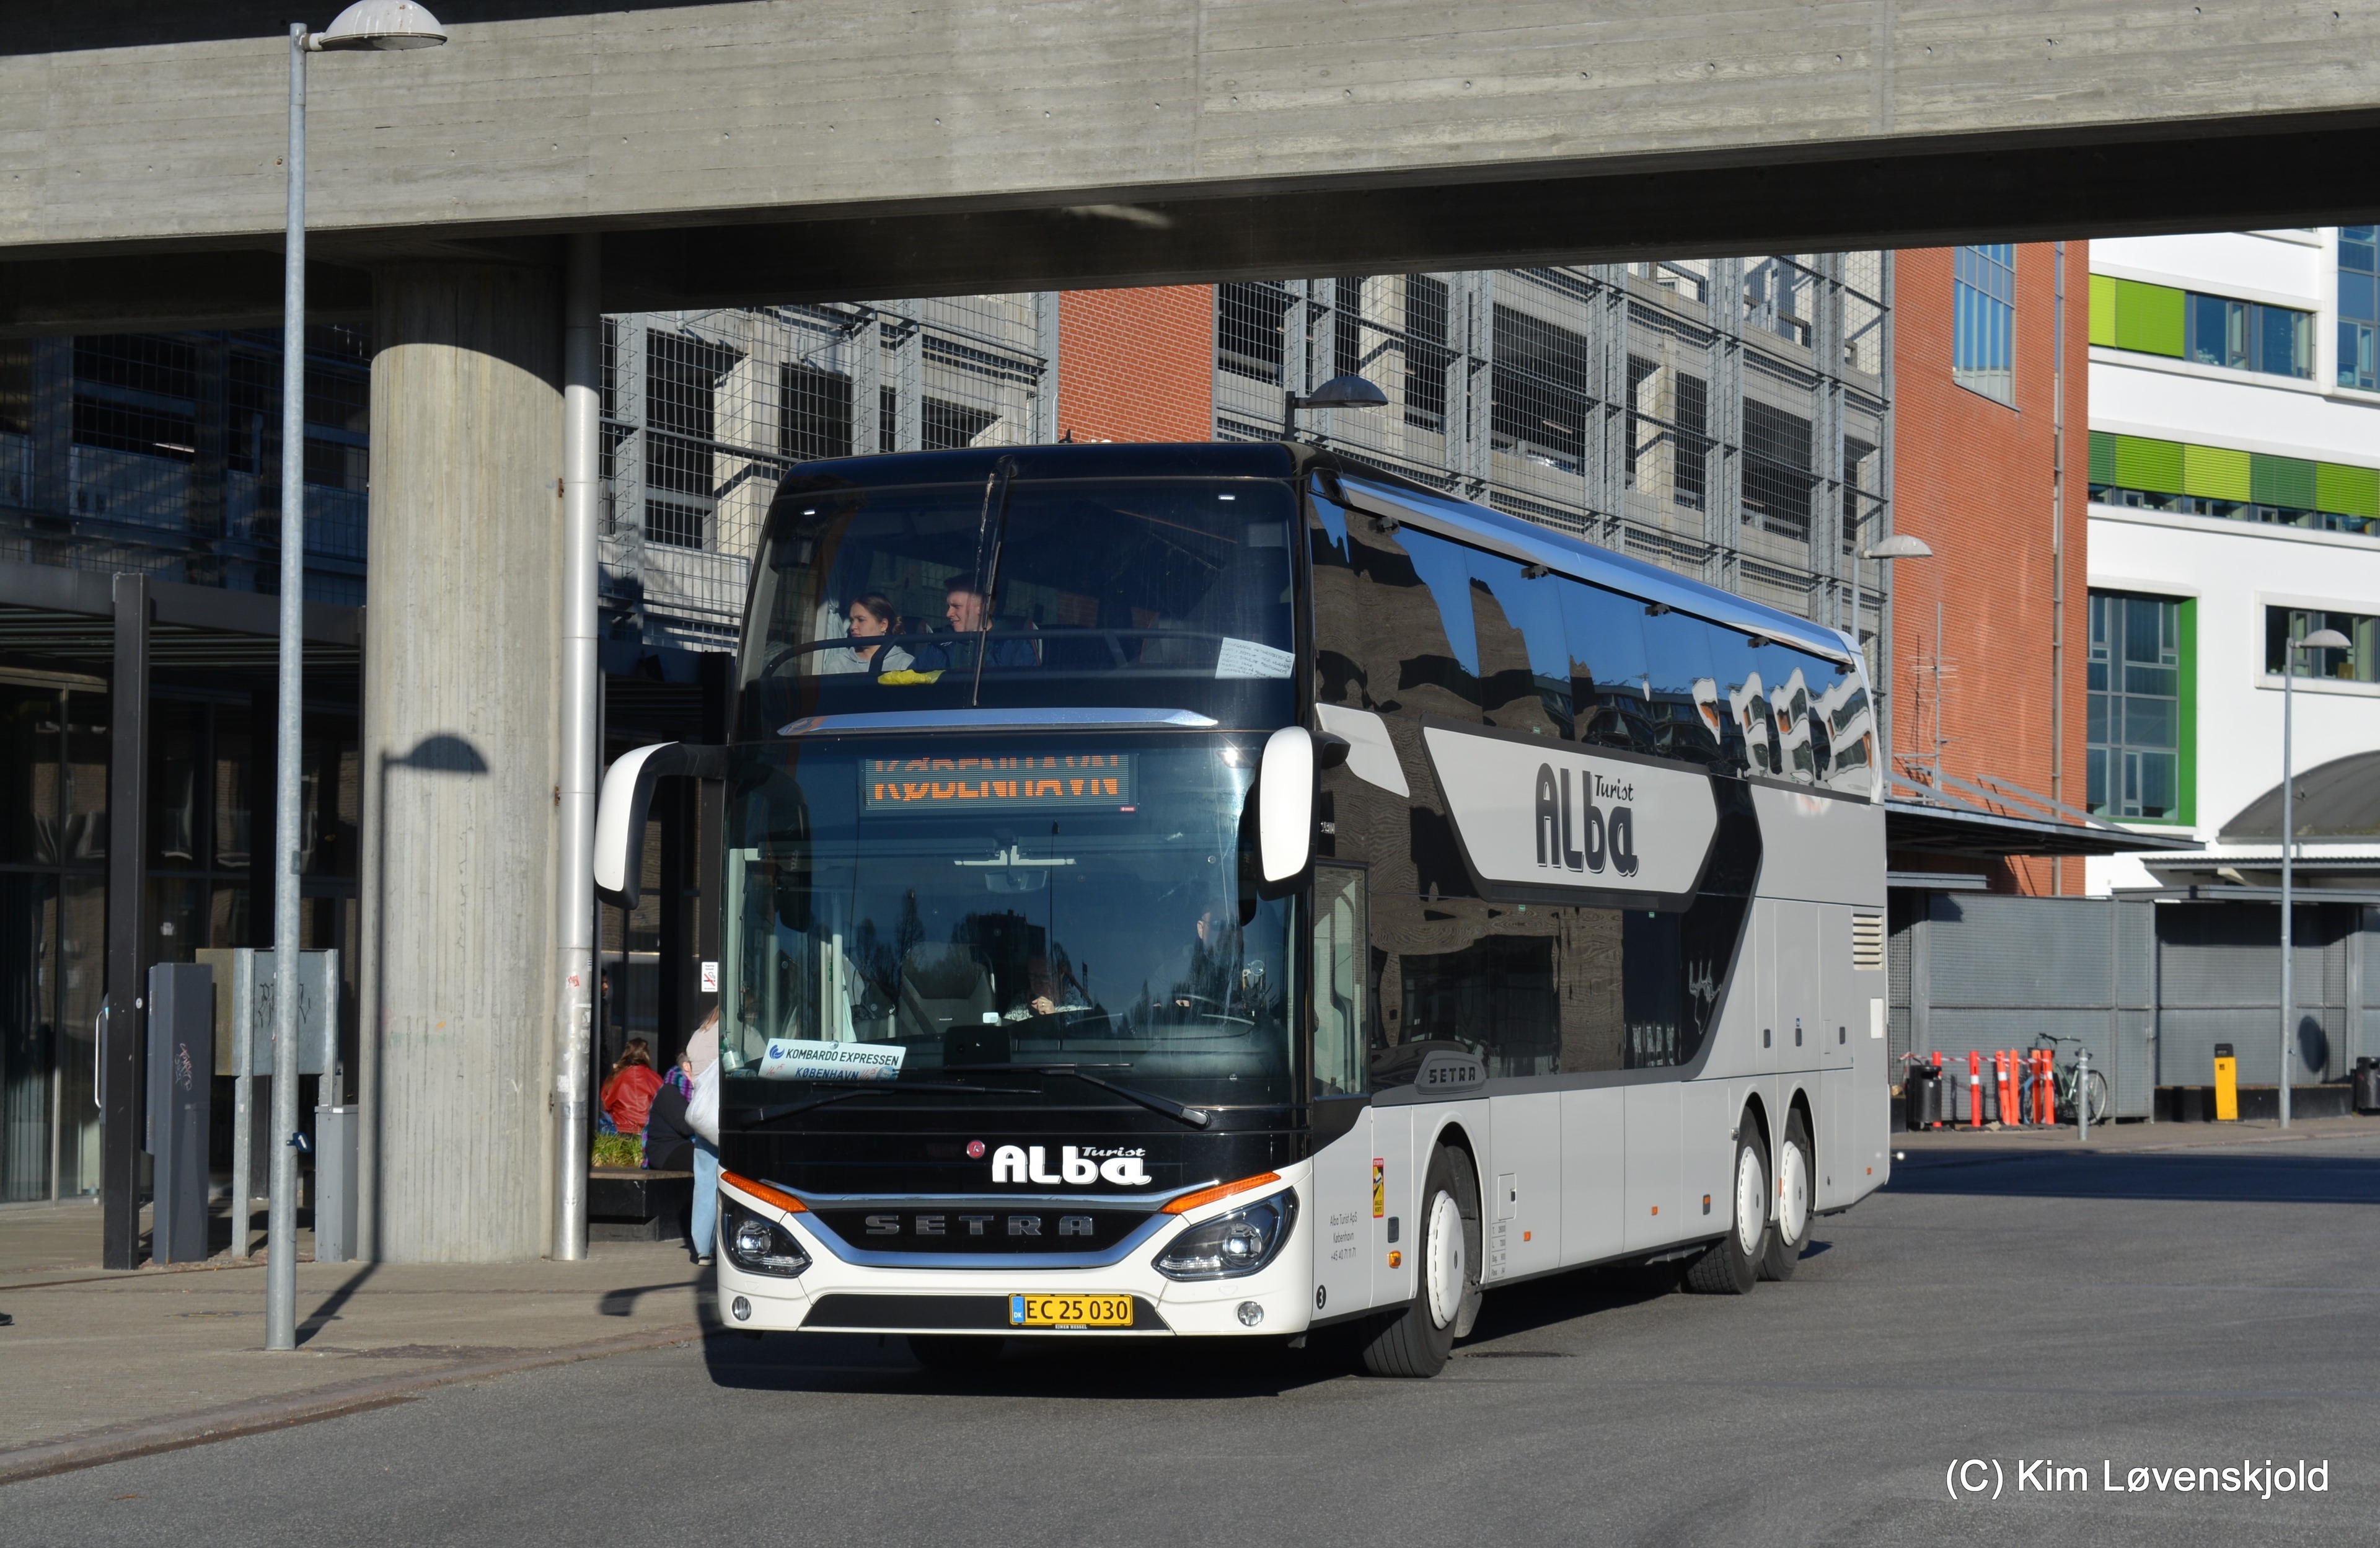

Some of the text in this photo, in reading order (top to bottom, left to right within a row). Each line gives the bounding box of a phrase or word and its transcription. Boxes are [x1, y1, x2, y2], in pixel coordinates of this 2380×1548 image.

[1594, 774, 1634, 802] Turist
[785, 1048, 899, 1066] KOMBARDO EXPRESSEN
[795, 1066, 860, 1081] KØBENHAVN
[1429, 1066, 1476, 1084] SETRA
[1082, 1146, 1147, 1157] Turist
[865, 1215, 1093, 1236] SETRA
[1329, 1211, 1357, 1227] Alba Turist ApS
[1319, 1288, 1324, 1306] 3
[1026, 1300, 1128, 1320] EC 25 030
